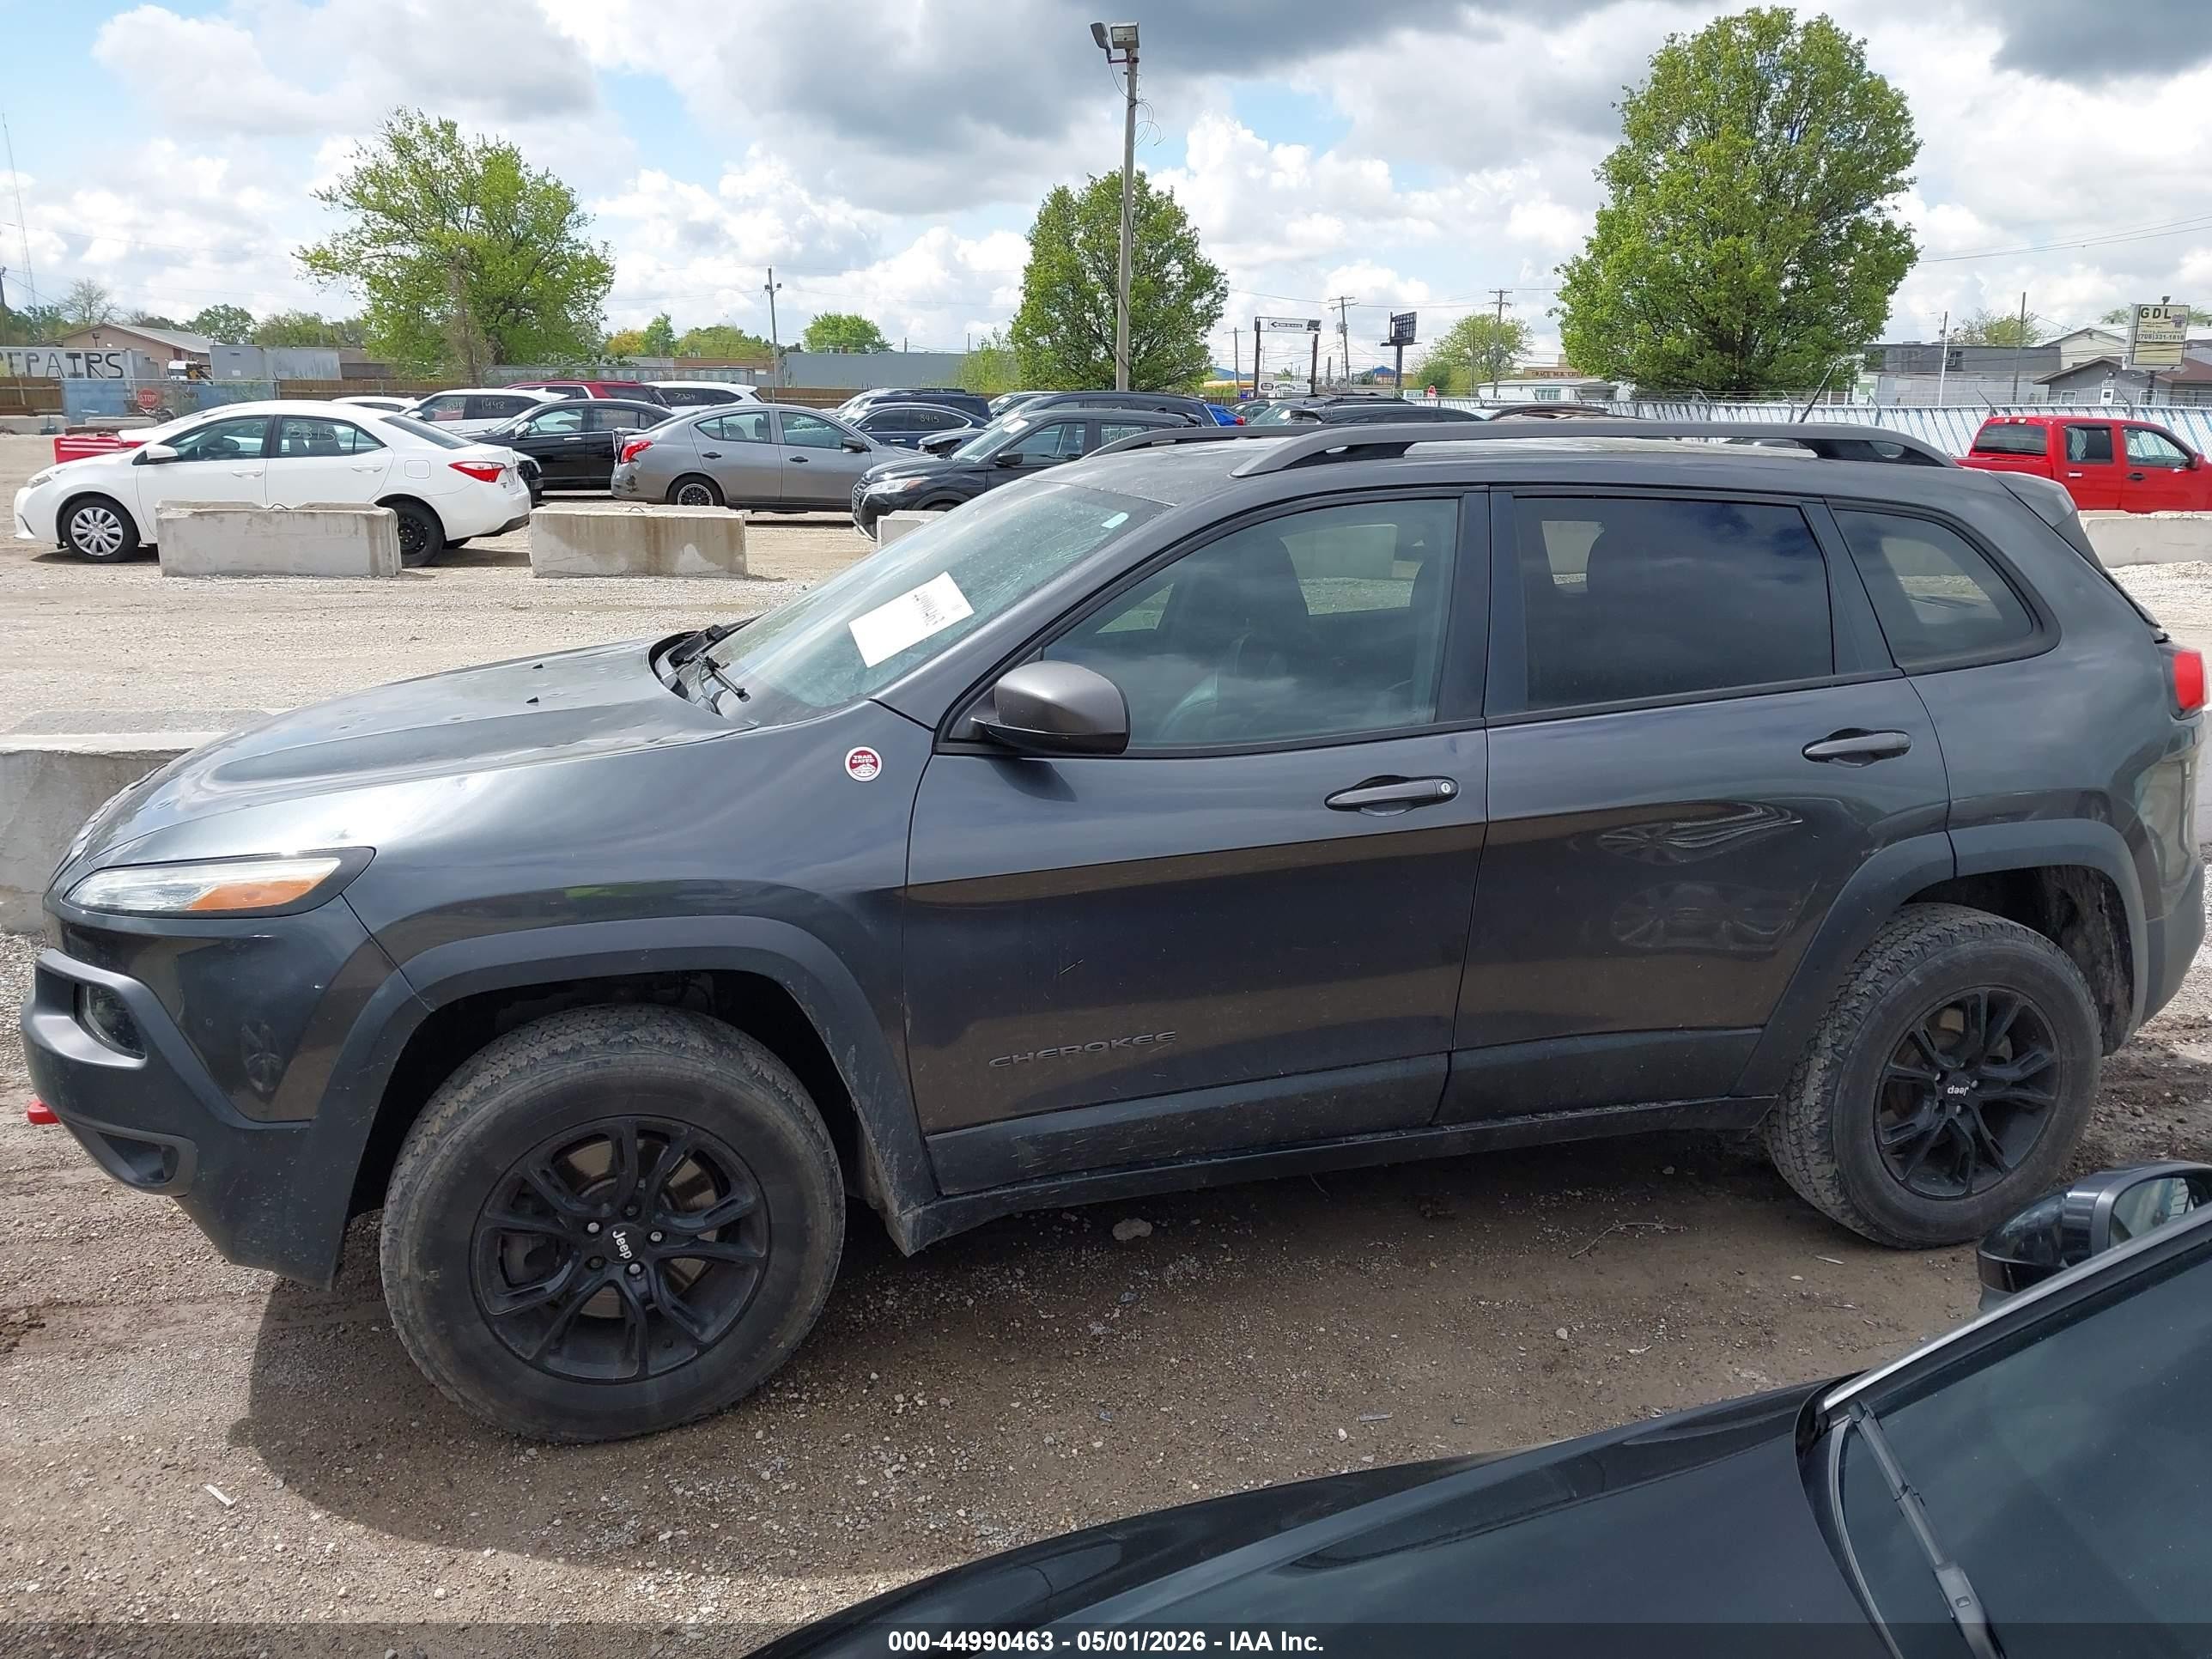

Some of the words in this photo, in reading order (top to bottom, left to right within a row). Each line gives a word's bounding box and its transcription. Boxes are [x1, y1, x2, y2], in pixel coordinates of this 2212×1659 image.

[2141, 307, 2172, 319] GDL
[0, 352, 124, 379] EPAIRS
[140, 394, 156, 403] STOP
[988, 1031, 1176, 1067] CHEROKEE
[1947, 1085, 1969, 1097] Jeep
[612, 1231, 632, 1259] Jeep
